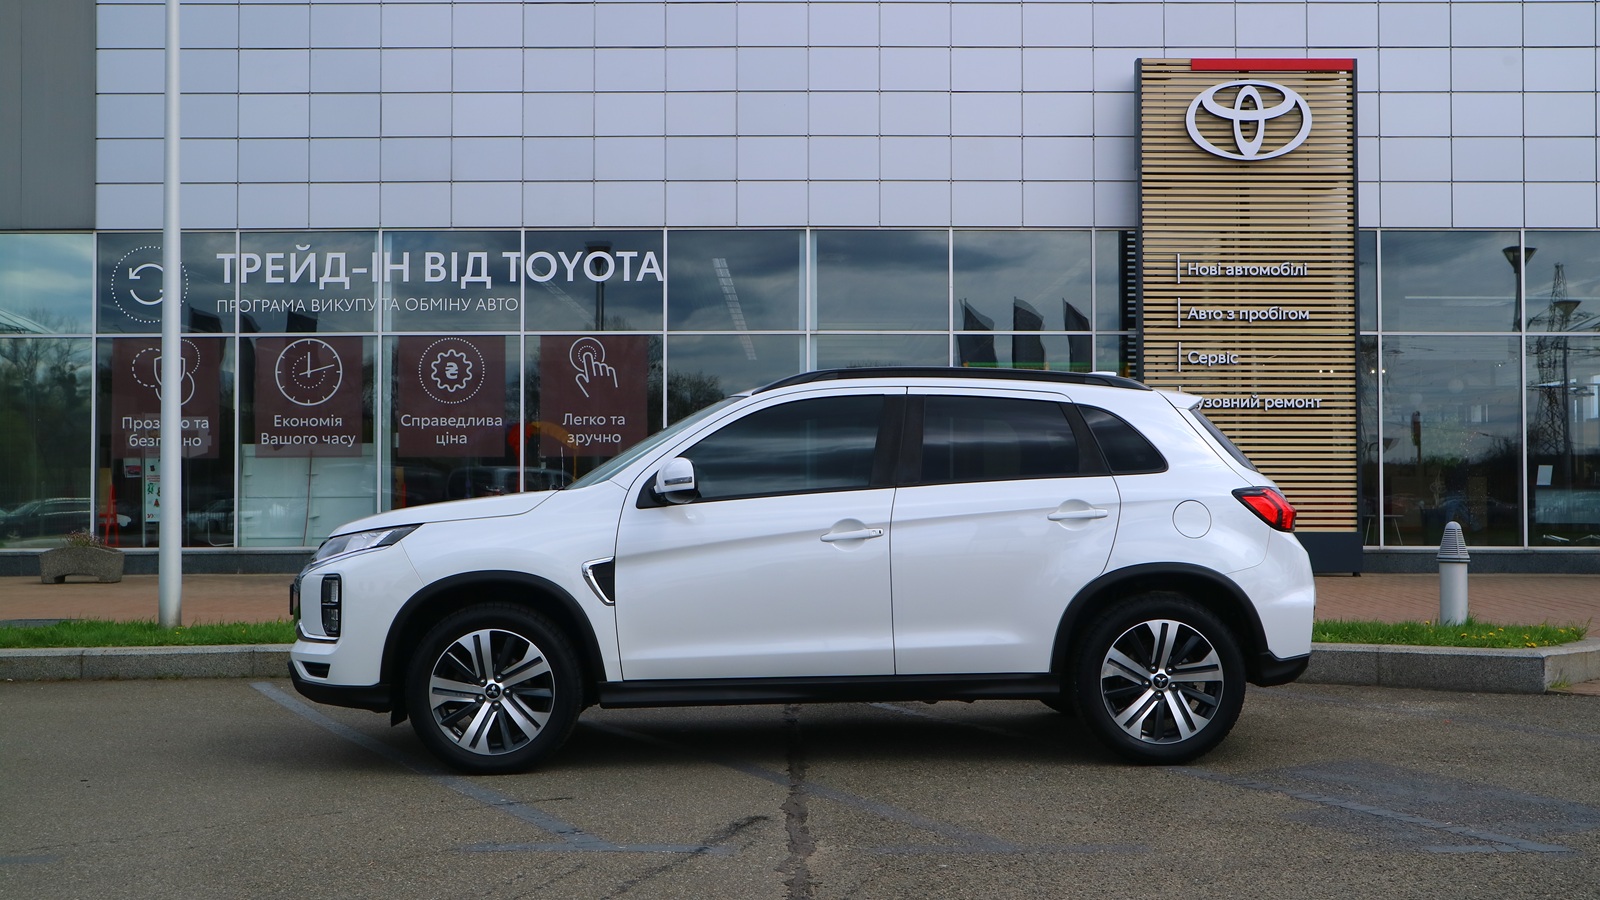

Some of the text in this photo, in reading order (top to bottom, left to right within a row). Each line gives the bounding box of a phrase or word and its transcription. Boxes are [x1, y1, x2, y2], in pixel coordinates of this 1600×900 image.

[216, 244, 664, 290] ТРЕЙД-ІН ВІД TOYOTA
[1188, 262, 1308, 276] Нові автомобілі
[217, 298, 519, 313] ПРОГРАМА ВИКУПУ ТА ОБМІНУ АВТО
[1187, 307, 1310, 323] Авто з пробігом
[1187, 351, 1239, 367] Сервіс
[1197, 395, 1322, 411] узовний ремонт
[122, 417, 209, 432] Прозо та
[273, 414, 342, 427] Економія
[401, 414, 503, 429] Справедлива
[562, 413, 626, 428] Легко та
[260, 433, 356, 448] Вашого часу
[436, 432, 468, 446] ціна
[567, 434, 622, 447] зручно
